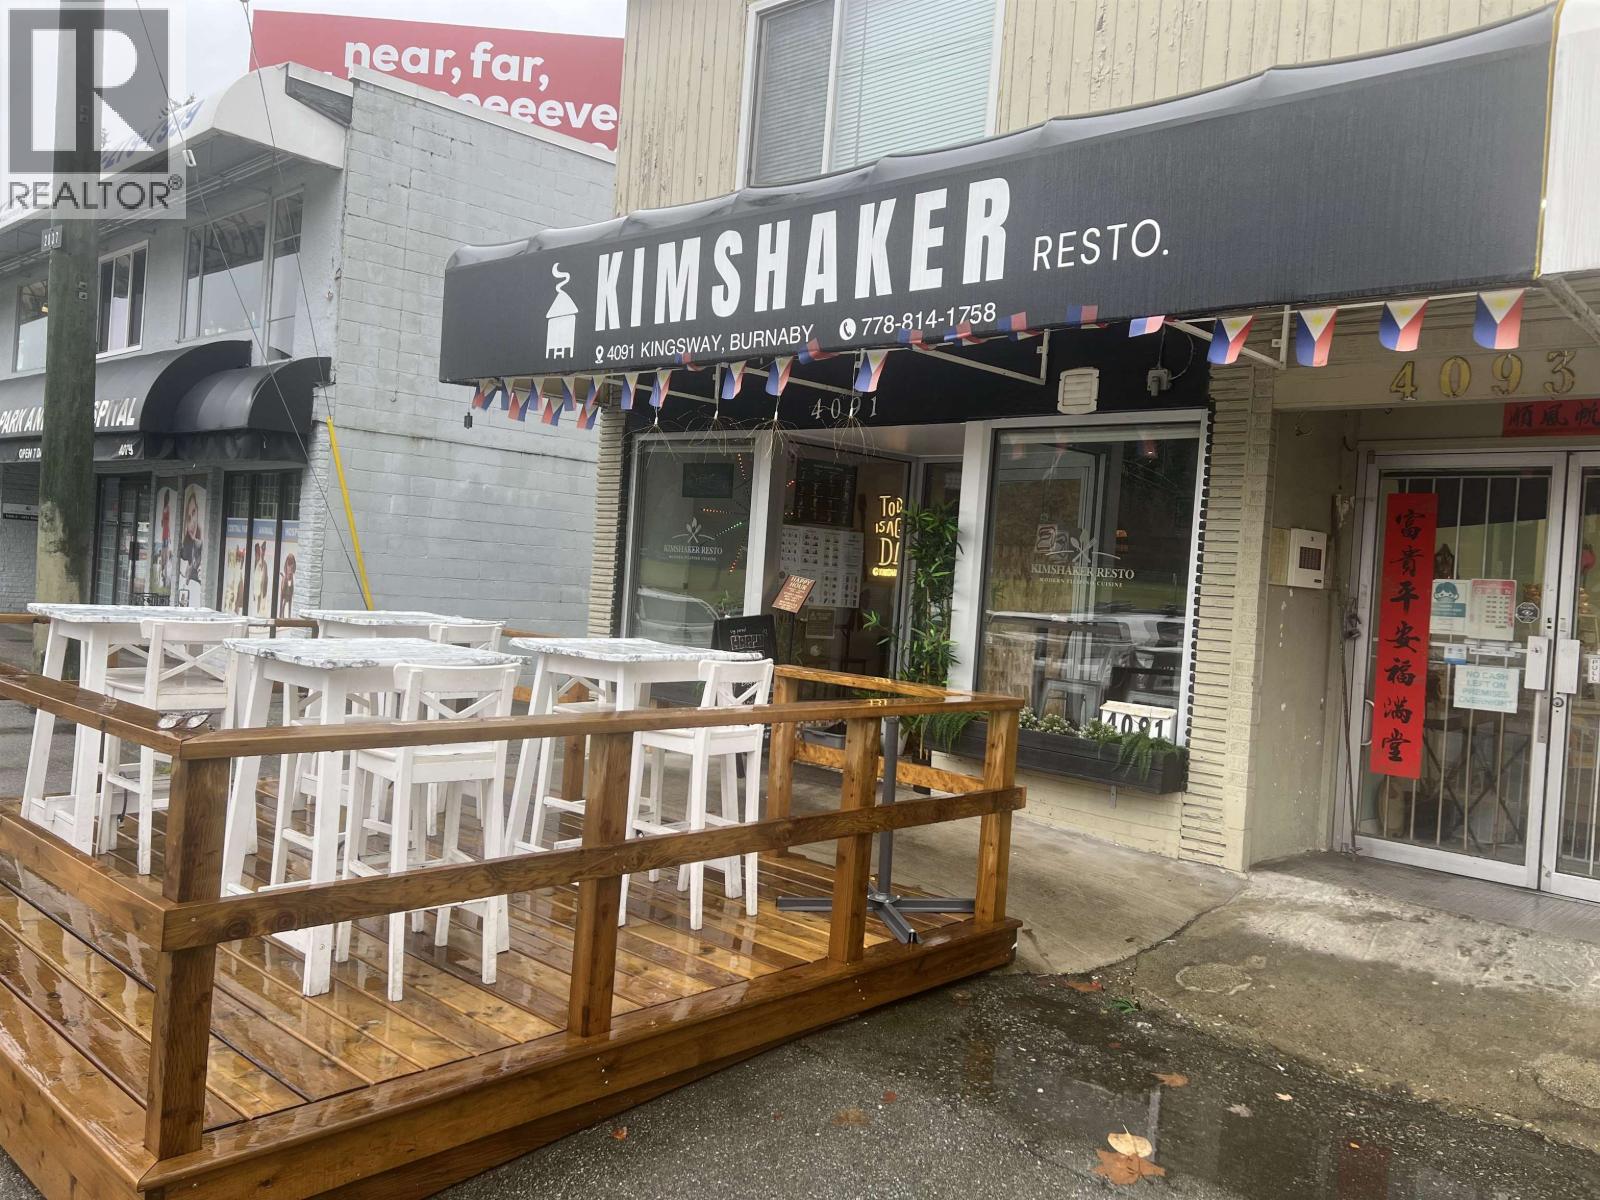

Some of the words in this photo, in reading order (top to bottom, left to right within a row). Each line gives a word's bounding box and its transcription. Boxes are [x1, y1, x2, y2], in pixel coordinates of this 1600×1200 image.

[344, 41, 462, 85] near,
[470, 41, 549, 91] far,
[593, 177, 1012, 332] KIMSHAKER
[1033, 217, 1170, 271] RESTO.
[861, 302, 997, 337] 778-814-1758
[607, 344, 636, 361] 4091
[640, 332, 726, 358] KINGSWAY,
[730, 323, 814, 350] BURNABY
[1389, 351, 1576, 402] 4093
[811, 396, 878, 421] 4091
[0, 408, 28, 434] PARK
[18, 448, 33, 459] OPEN
[702, 546, 723, 555] RESTO
[791, 576, 811, 585] HAPPY
[1031, 563, 1093, 577] KIMSHAKER
[1096, 567, 1135, 580] RESTO
[789, 582, 807, 591] HOUR
[1466, 670, 1480, 679] NO
[1482, 671, 1509, 681] CASH
[1467, 680, 1490, 688] LEFT
[1492, 681, 1507, 689] ON
